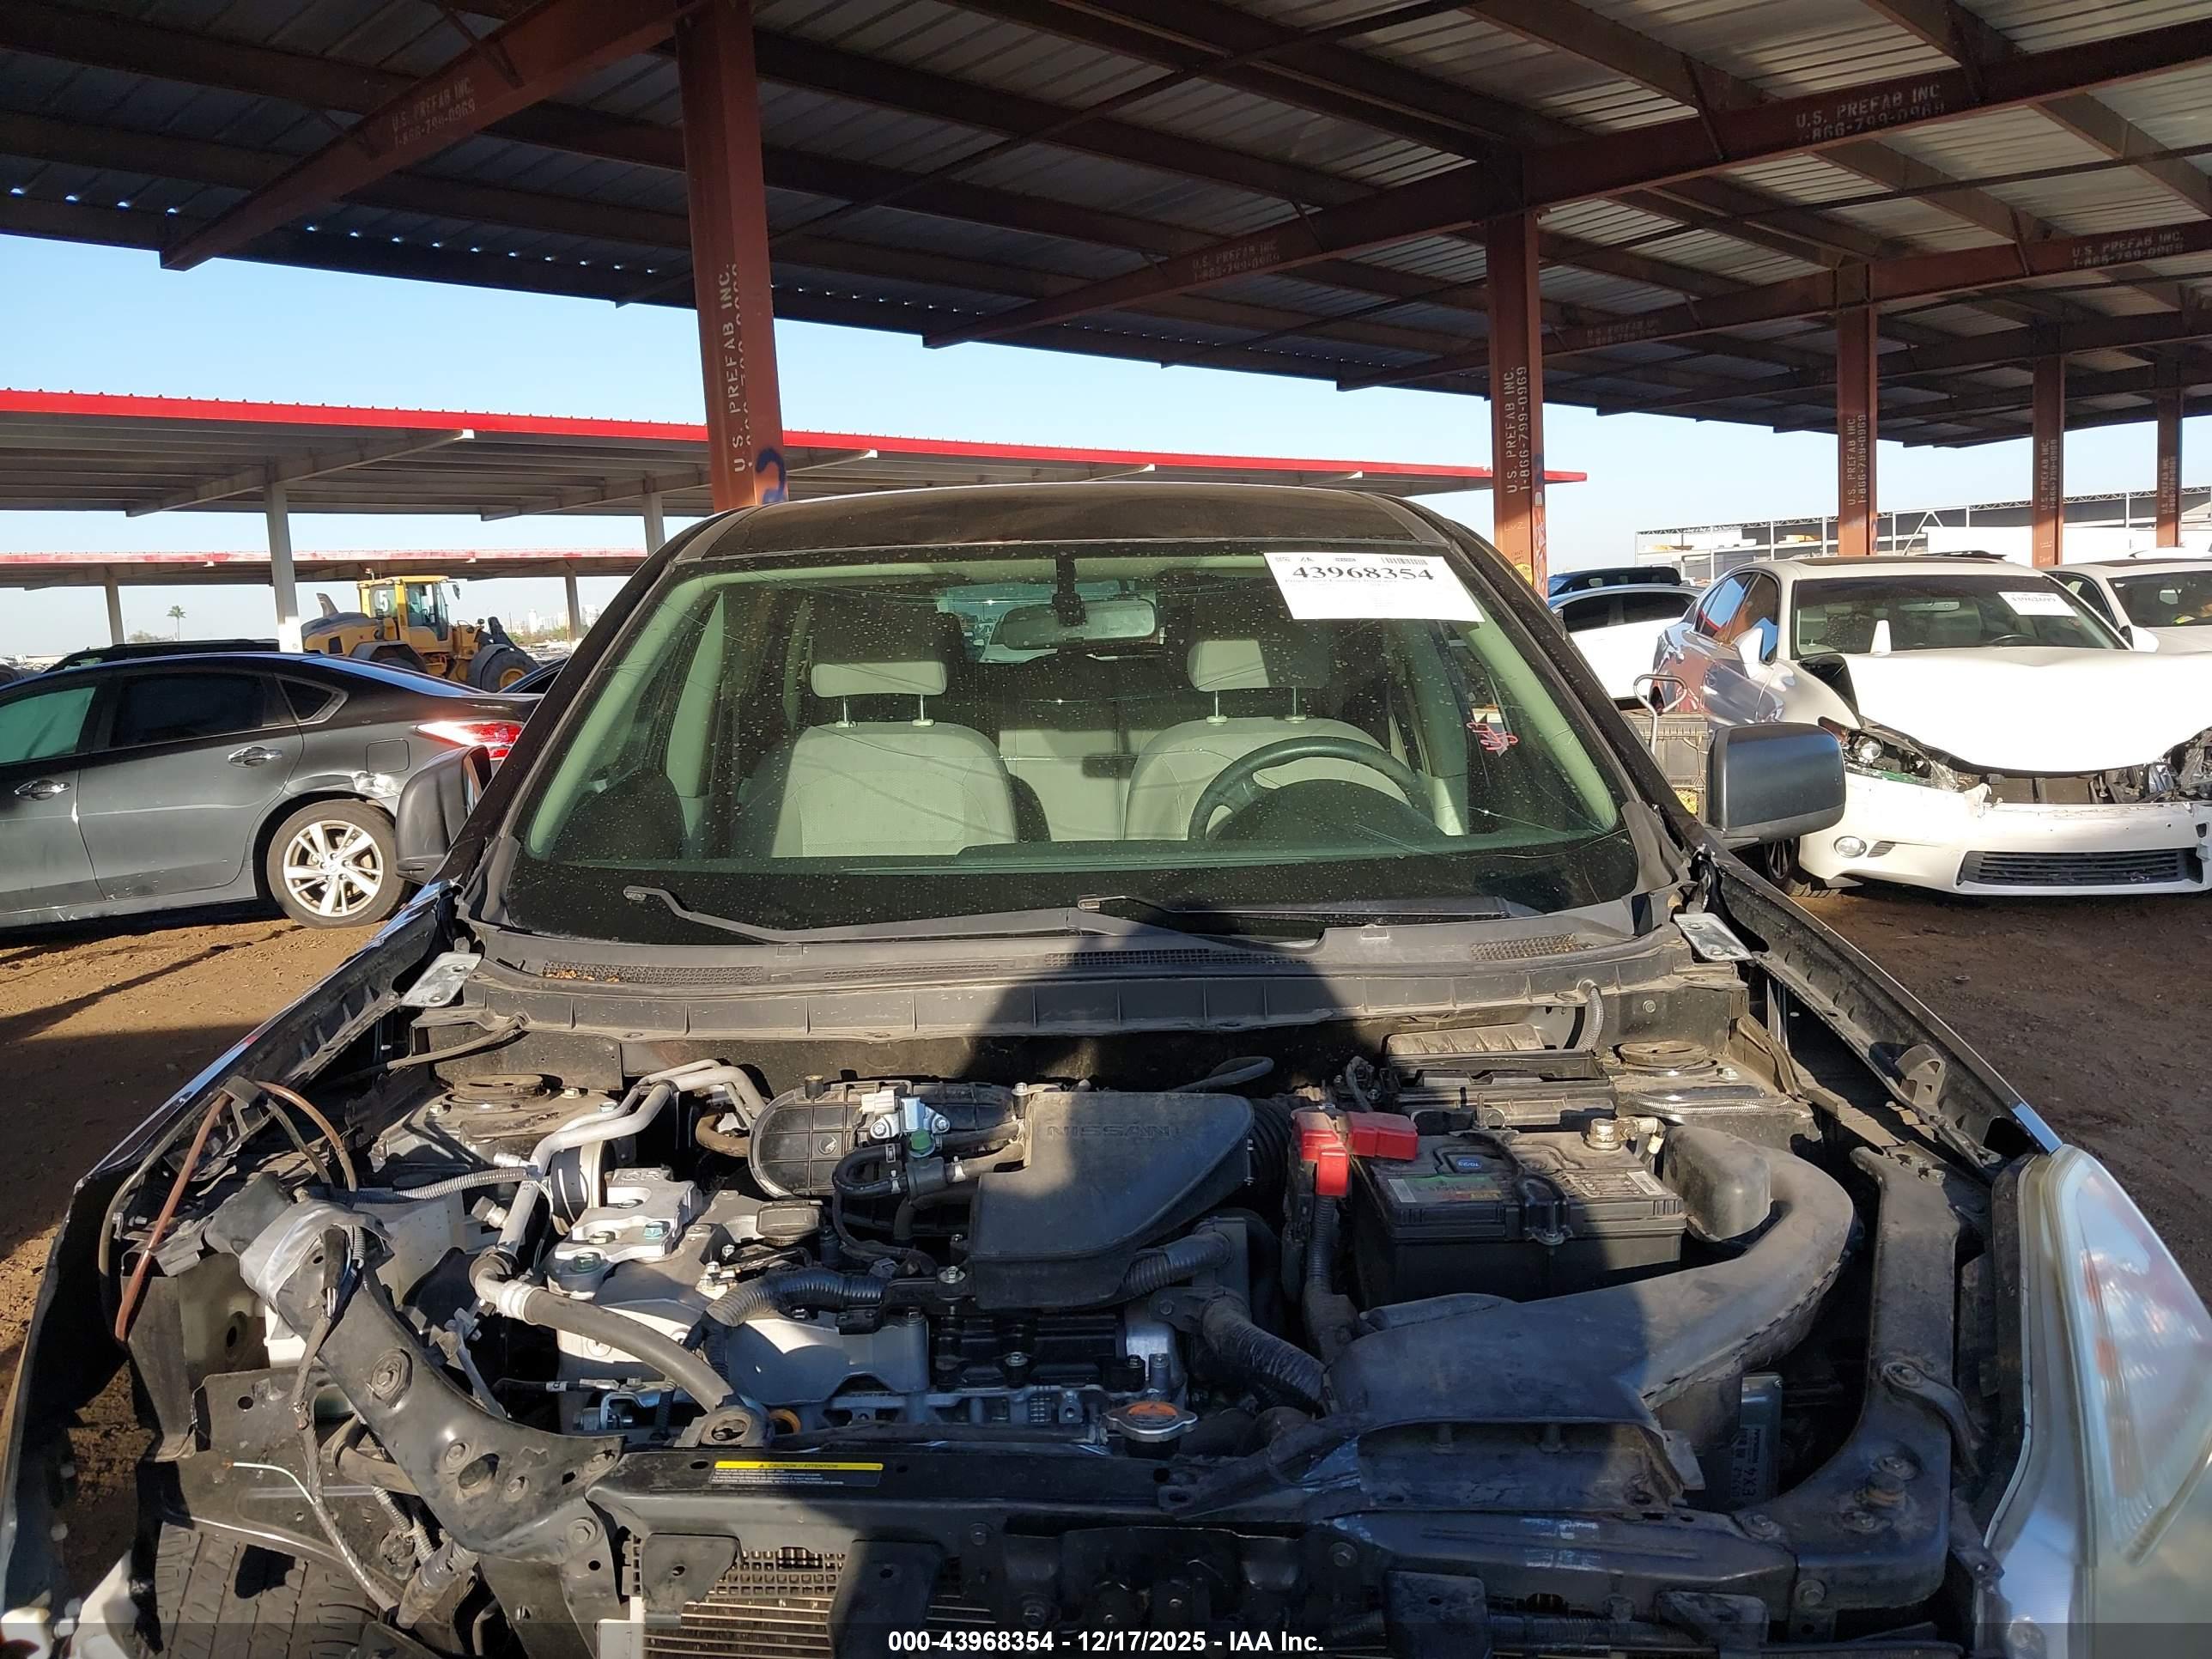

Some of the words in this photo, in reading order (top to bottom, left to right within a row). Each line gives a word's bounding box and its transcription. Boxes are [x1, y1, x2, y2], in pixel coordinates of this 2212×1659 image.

[1796, 110, 1826, 128] U.S.
[1837, 92, 1902, 119] PREFAB
[718, 264, 733, 310] INC.
[722, 322, 741, 414] PREFAB
[1504, 367, 1515, 395] INC.
[1504, 402, 1517, 458] PREFAB
[1516, 367, 1531, 490] 1-866-799-0969
[732, 428, 746, 472] U.S.
[1847, 440, 1856, 480] PREFAB
[1506, 465, 1518, 494] U.S.
[1292, 567, 1435, 580] 43968354
[378, 590, 389, 612] 5
[1047, 1125, 1170, 1138] NISSAN
